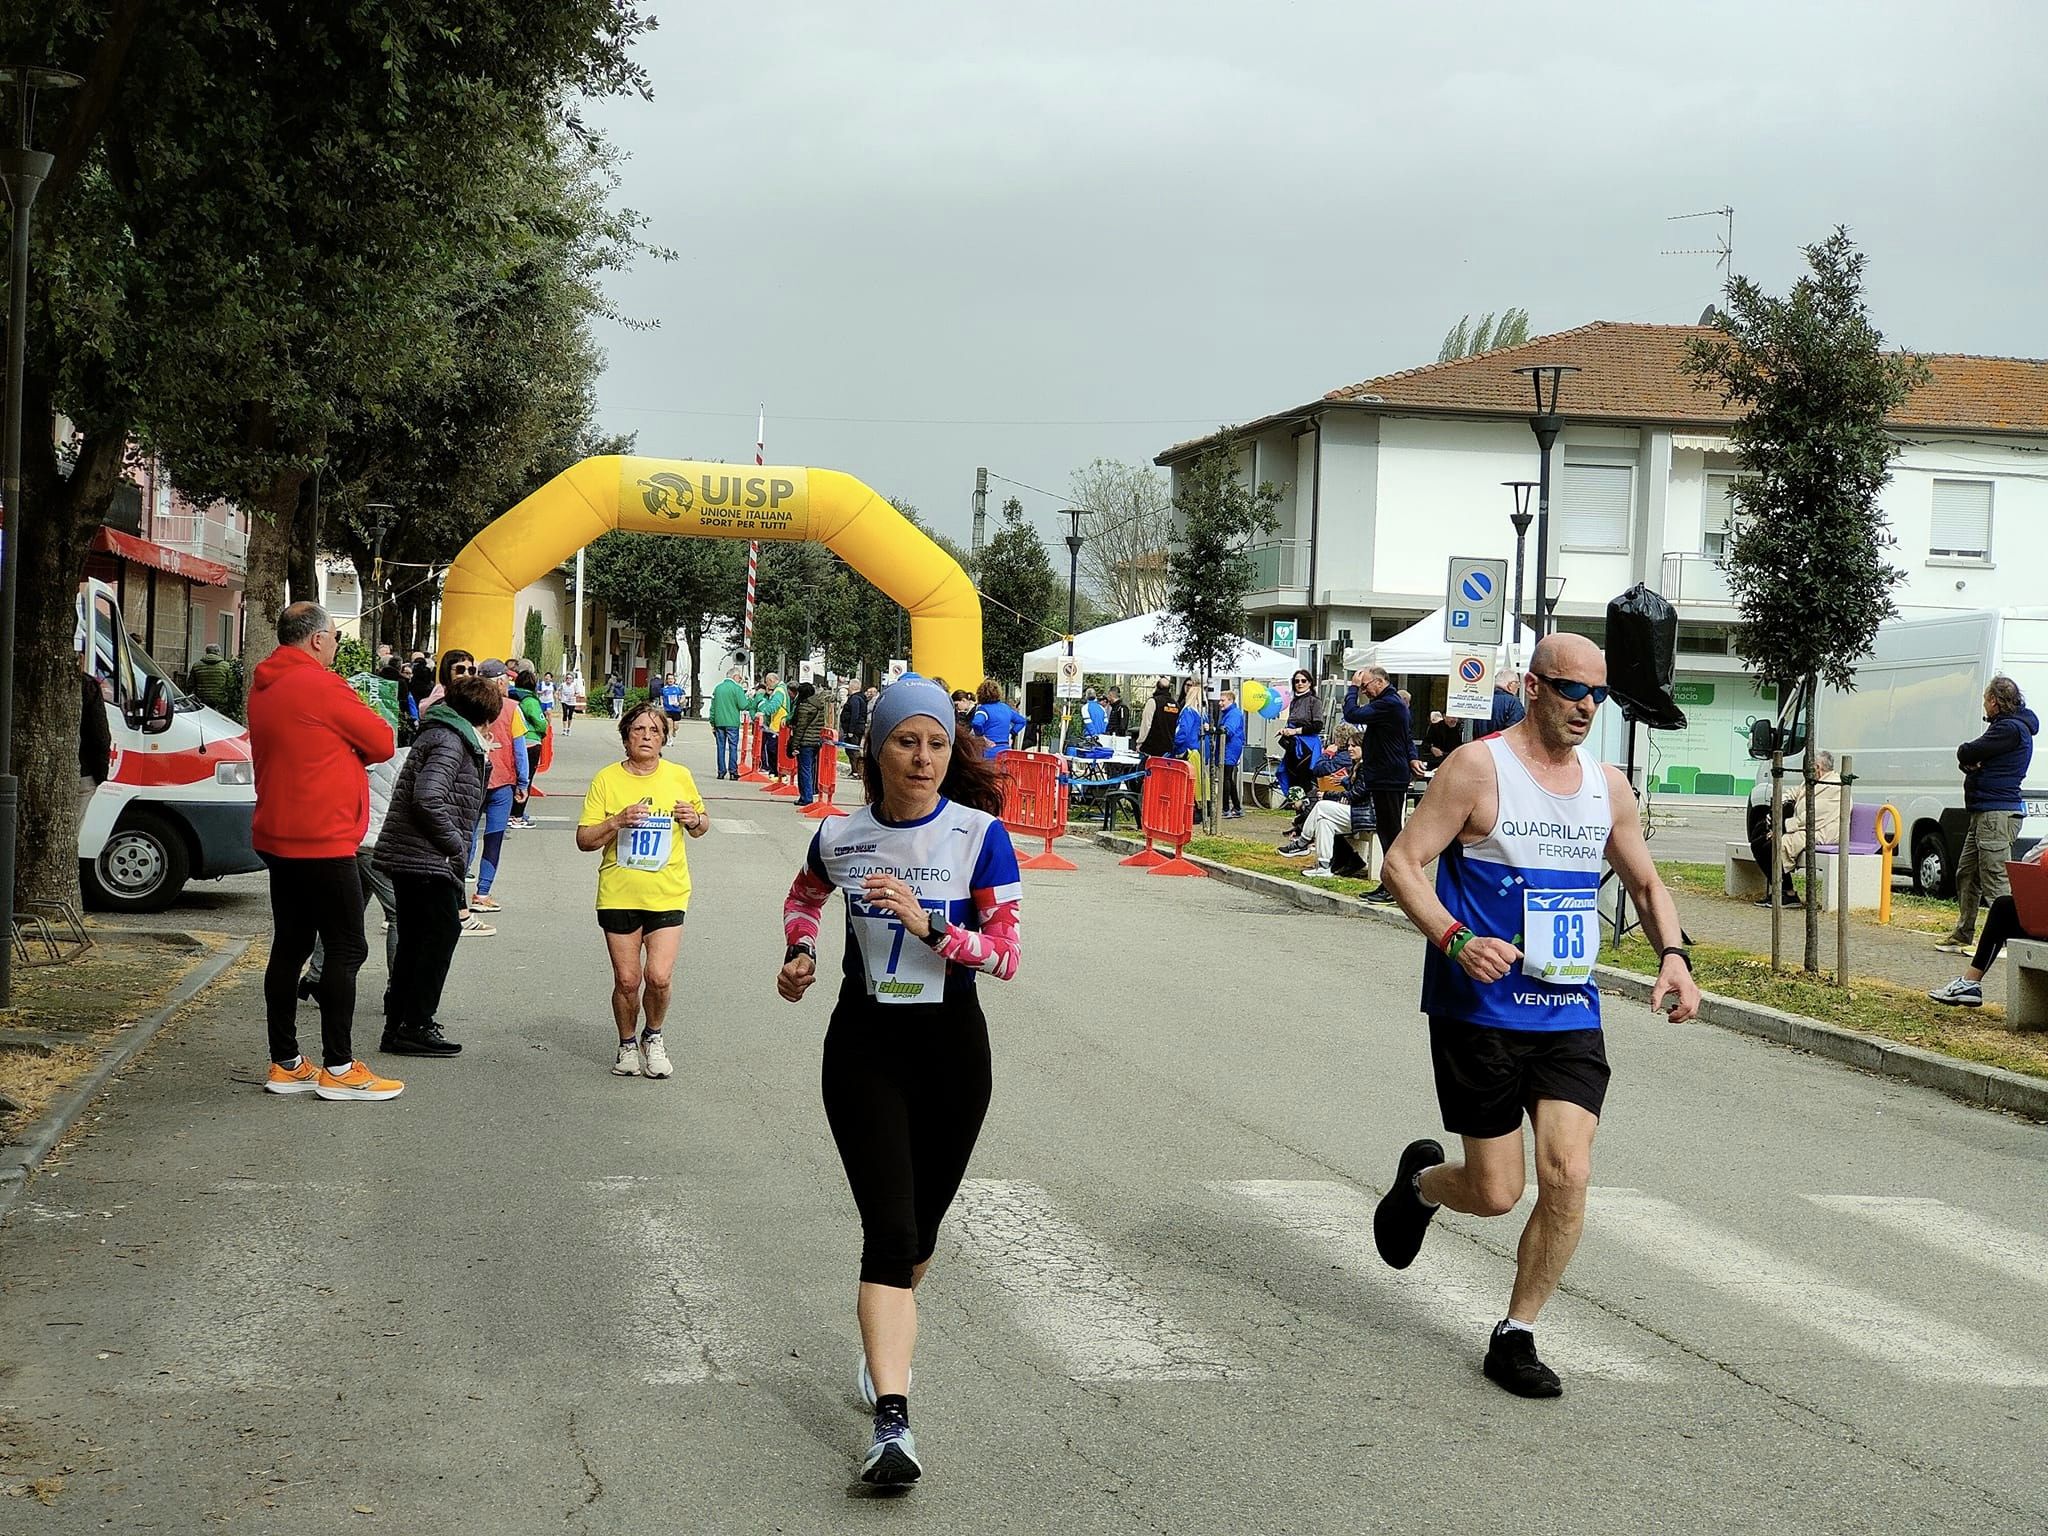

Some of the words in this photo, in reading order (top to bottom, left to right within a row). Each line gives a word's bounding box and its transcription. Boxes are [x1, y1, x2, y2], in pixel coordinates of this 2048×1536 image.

[702, 475, 794, 508] UISP
[700, 507, 741, 519] UNIONE
[746, 510, 793, 521] ITALIANA
[700, 517, 732, 528] SPORT
[737, 520, 755, 529] PER
[761, 521, 786, 530] TUTTI
[1501, 820, 1610, 841] QUADRILATER
[630, 830, 662, 856] 187
[1538, 843, 1598, 859] FERRARA
[1552, 914, 1585, 959] 83
[886, 922, 906, 975] 7
